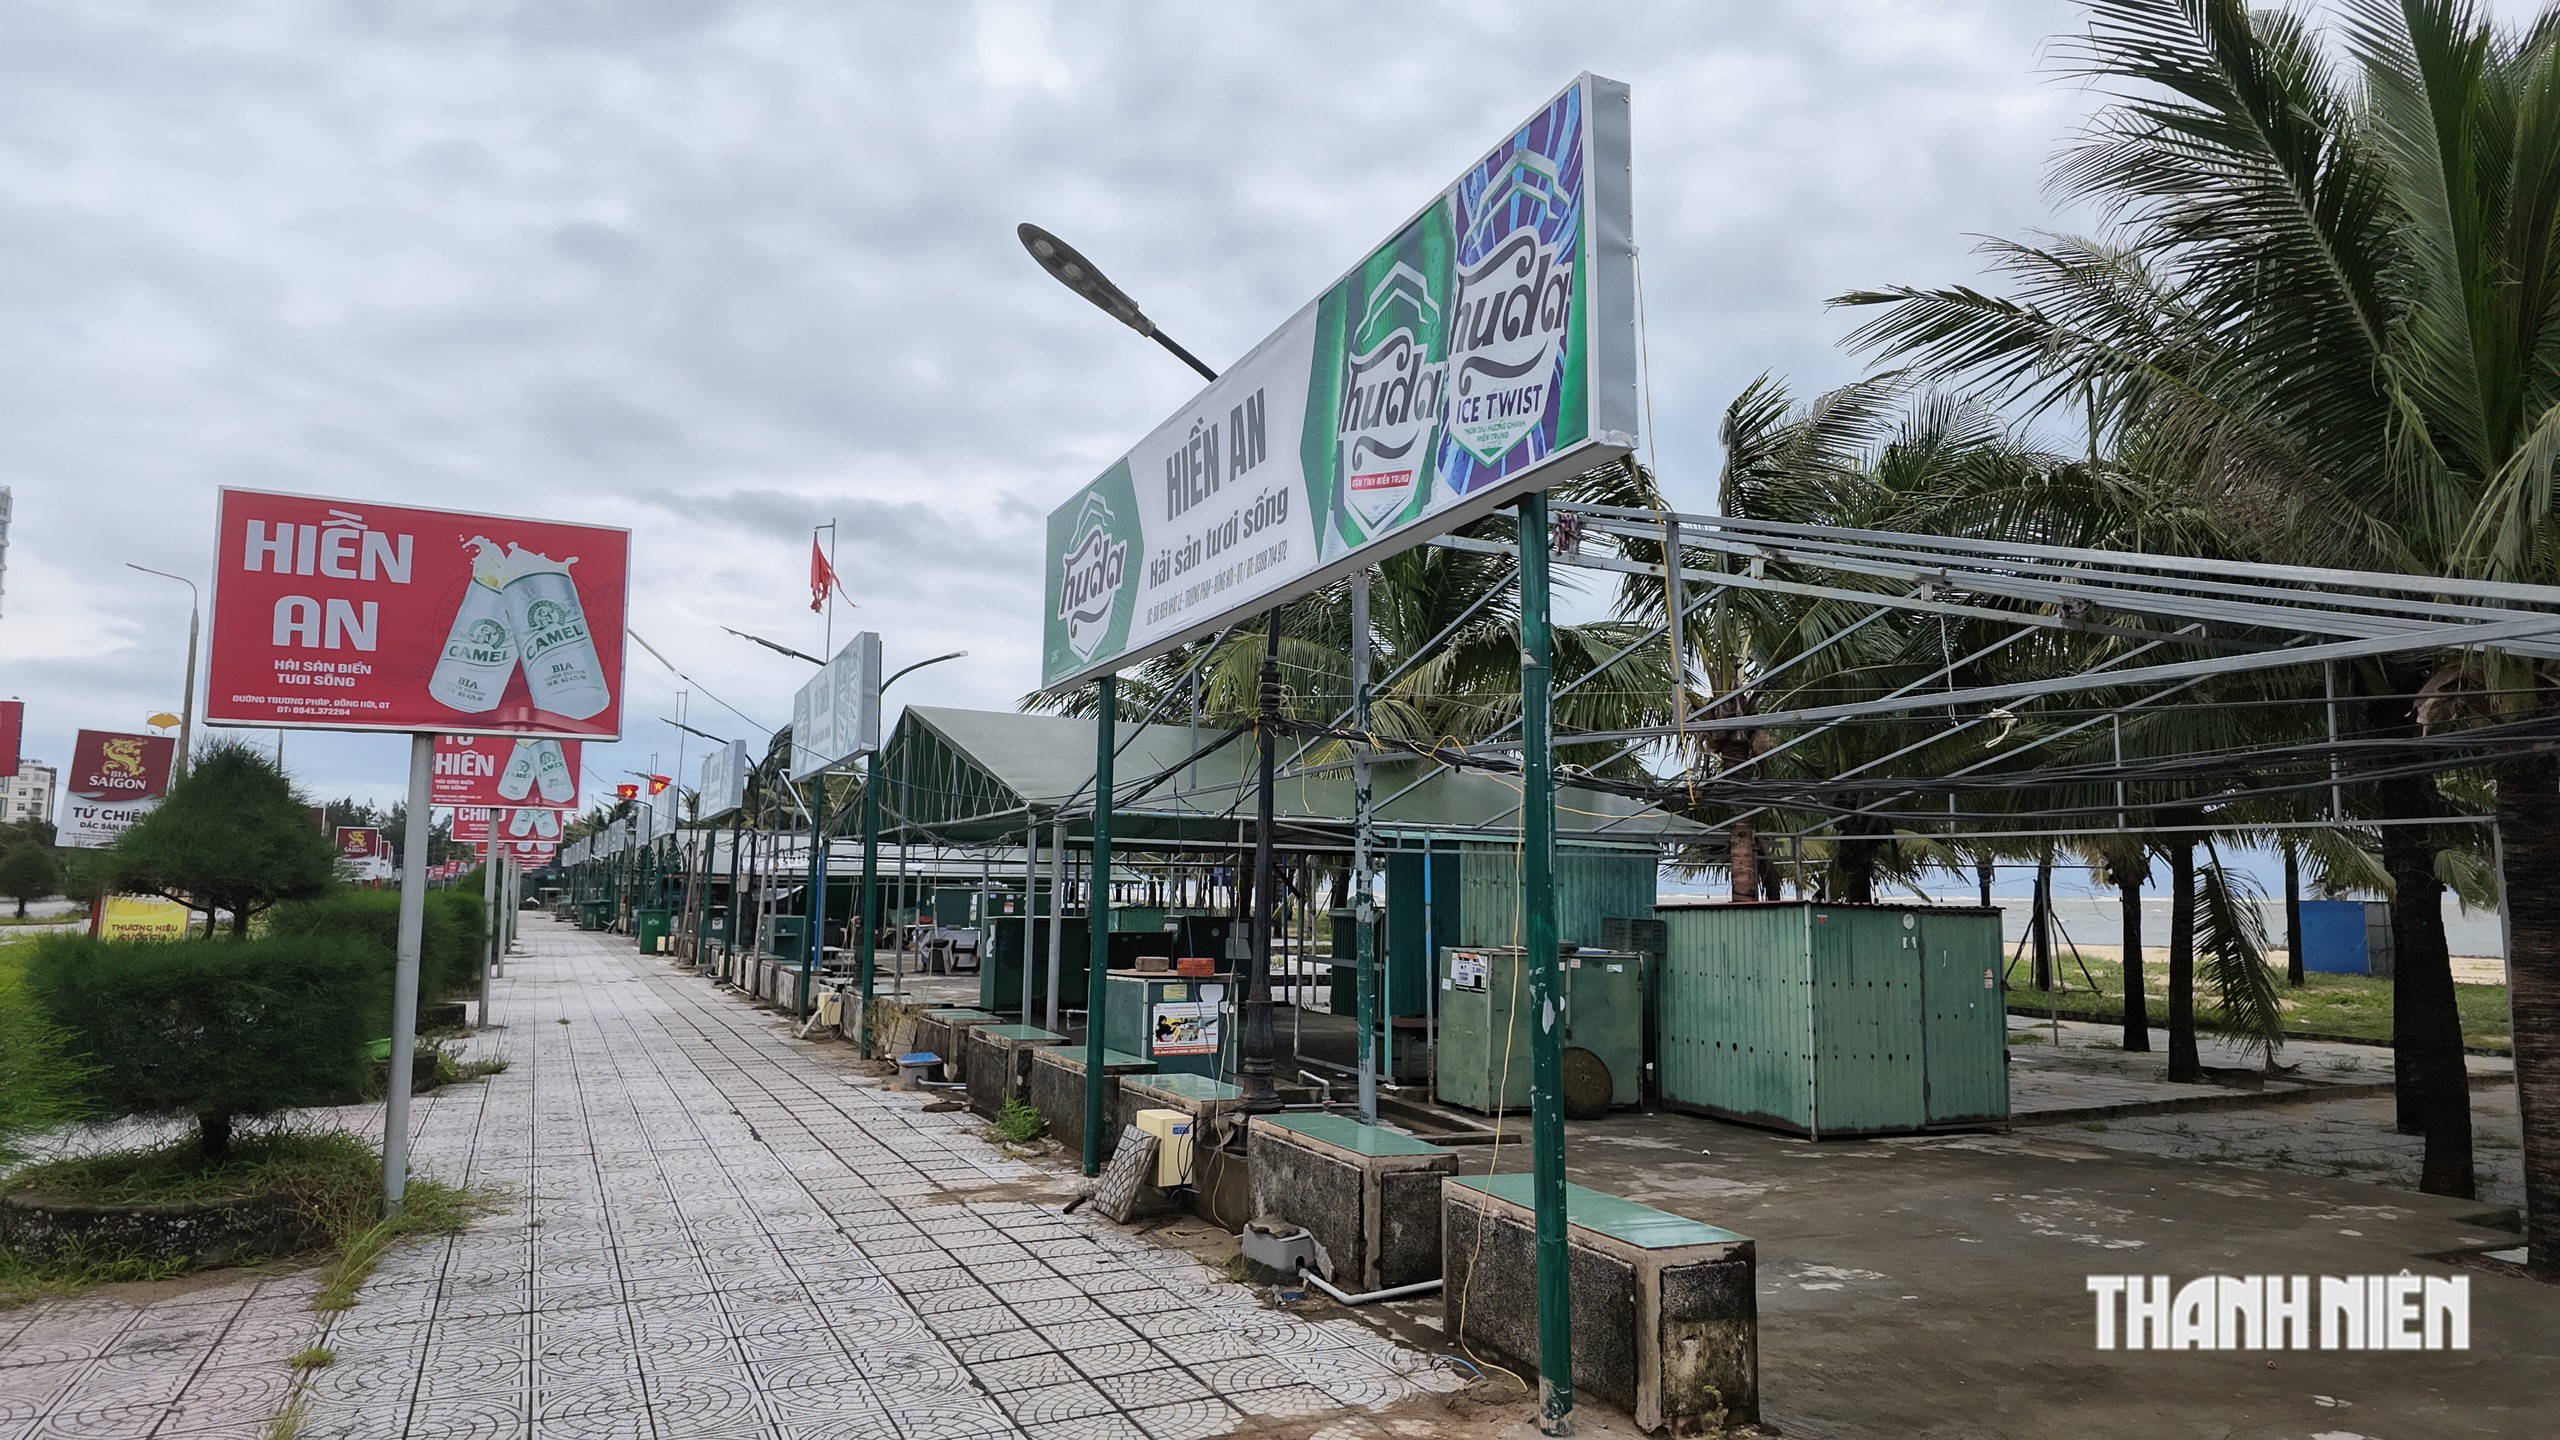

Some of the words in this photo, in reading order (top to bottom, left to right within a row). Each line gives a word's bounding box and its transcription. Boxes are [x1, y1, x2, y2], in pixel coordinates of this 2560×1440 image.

[1456, 396, 1481, 424] ICE
[1486, 384, 1543, 420] TWIST
[1166, 416, 1220, 523] HIỀN
[1229, 386, 1267, 483] AN
[243, 509, 414, 584] HIỀN
[1150, 549, 1171, 590] Hải
[1175, 534, 1201, 577] sản
[1206, 509, 1239, 560] tươi
[1243, 486, 1289, 539] sống
[1060, 529, 1125, 616] huda
[272, 595, 379, 652] AN
[449, 645, 511, 663] CAMEL
[526, 623, 584, 661] CAMEL
[274, 658, 300, 671] HẢI
[303, 660, 335, 673] SẢN
[551, 662, 574, 674] BIA
[458, 676, 478, 689] BIA
[110, 770, 128, 778] BIA
[432, 749, 495, 777] HIÊN
[89, 775, 147, 790] SAIGON
[73, 805, 99, 819] TỨ
[101, 808, 142, 822] CHIÊ
